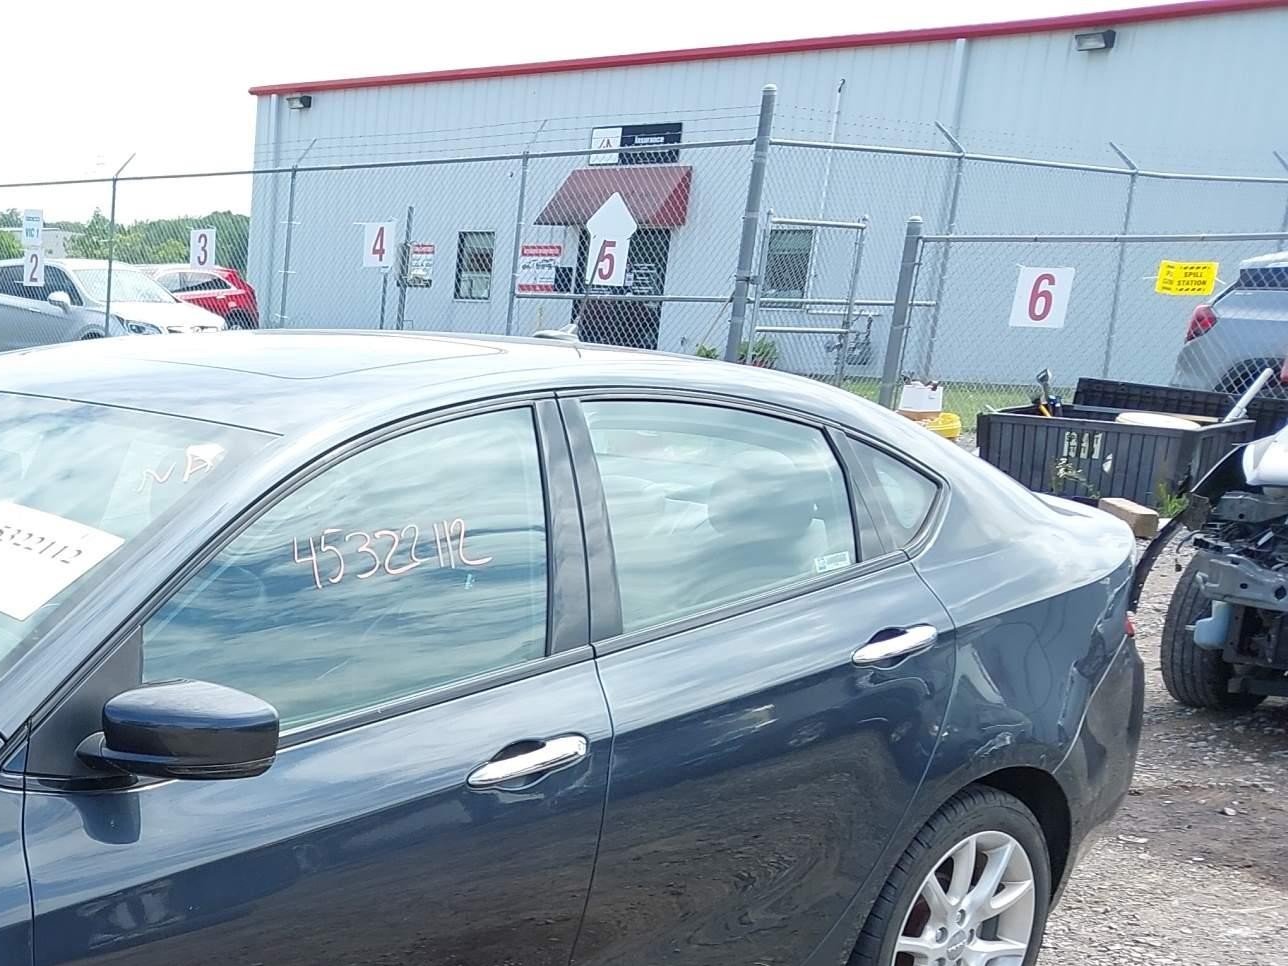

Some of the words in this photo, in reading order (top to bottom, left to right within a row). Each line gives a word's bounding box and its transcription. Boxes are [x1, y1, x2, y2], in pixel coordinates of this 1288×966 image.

[197, 233, 208, 266] 3
[372, 226, 385, 262] 4
[598, 239, 617, 281] 5
[29, 253, 39, 283] 2
[1028, 273, 1056, 321] 6
[293, 518, 493, 589] 45322112
